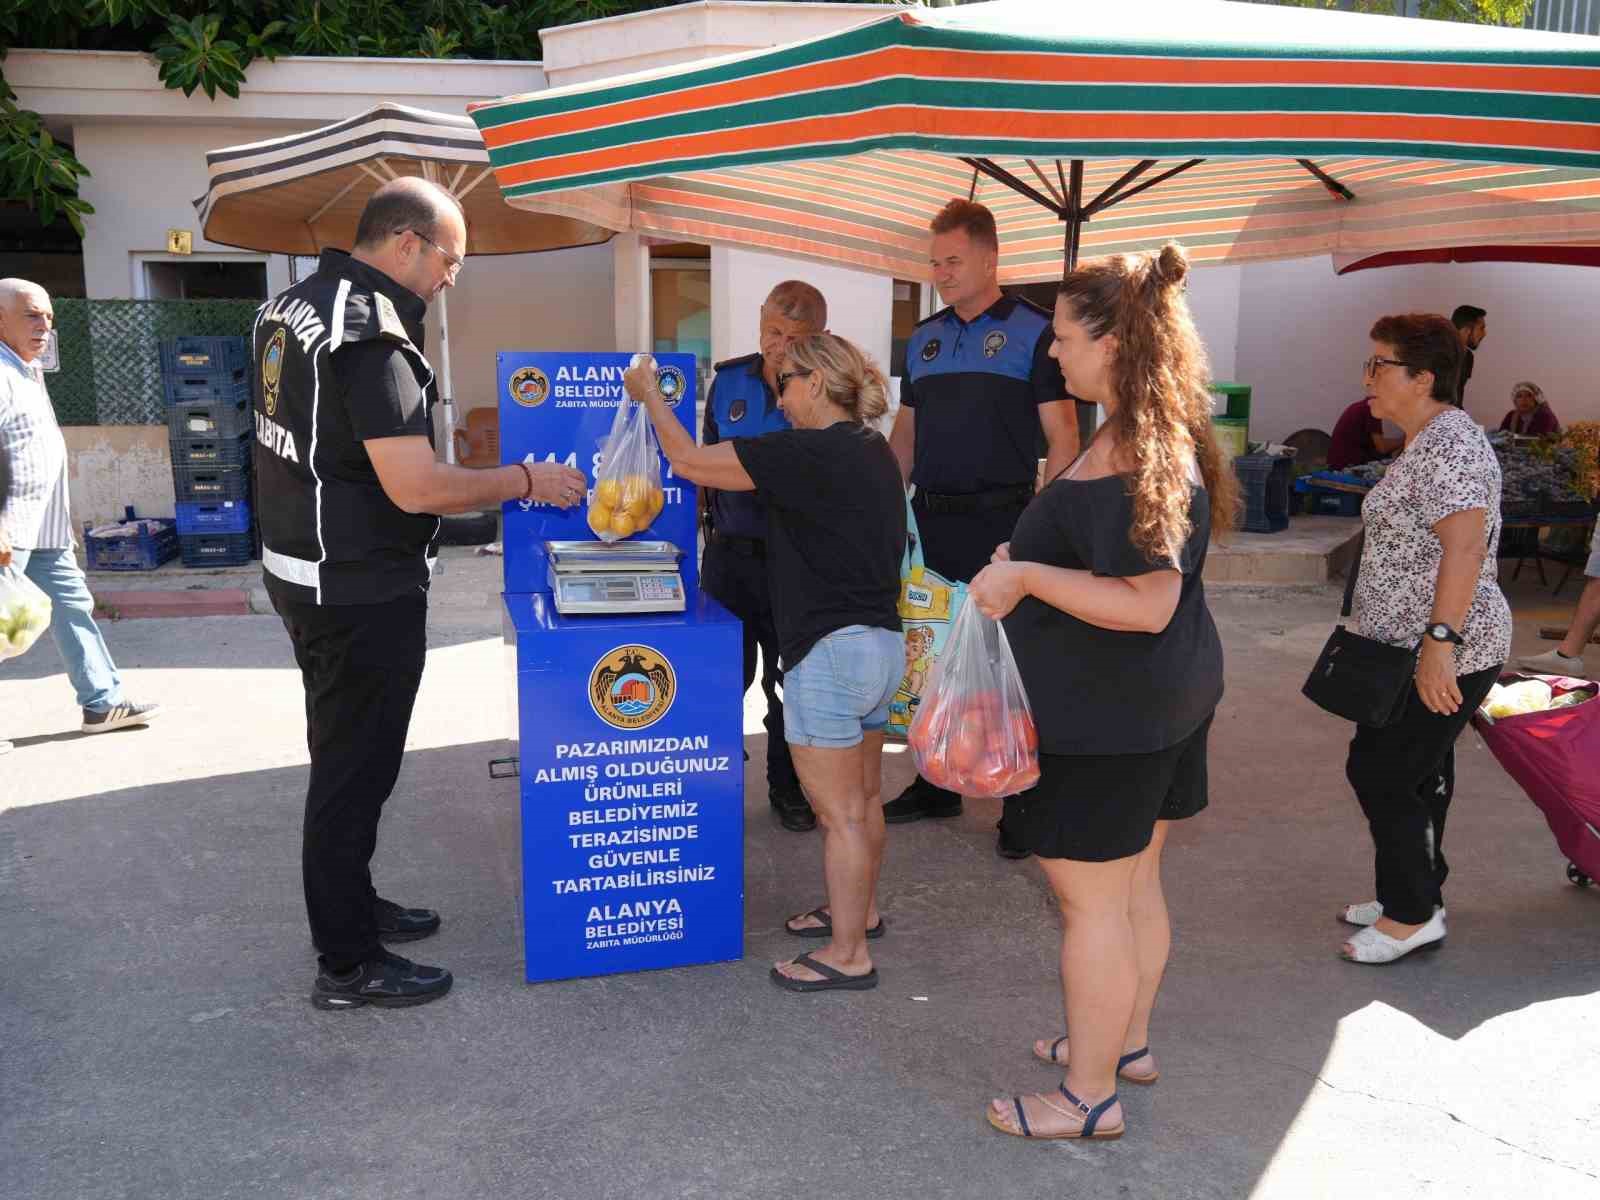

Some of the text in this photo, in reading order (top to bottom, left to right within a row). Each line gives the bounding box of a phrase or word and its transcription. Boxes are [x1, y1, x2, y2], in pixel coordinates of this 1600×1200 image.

[259, 296, 326, 354] ALANYA
[555, 366, 631, 381] ALANY
[554, 383, 625, 398] BELEDİY
[555, 400, 587, 408] ZABITA
[556, 736, 709, 759] PAZARIMIZDAN
[534, 756, 729, 784] ALMIŞ OLDUĞUNUZ
[584, 777, 682, 802] ÜRÜNLERİ
[569, 800, 698, 826] BELEDİYEMİZ
[568, 824, 699, 849] TERAZİSİNDE
[588, 848, 681, 869] GÜVENLE
[552, 865, 715, 895] TARTABİLİRSİNİZ
[586, 898, 682, 922] ALANYA
[585, 913, 684, 939] BELEDİYESİ
[586, 931, 684, 950] ZABITA MÜDÜRLÜĞÜ
